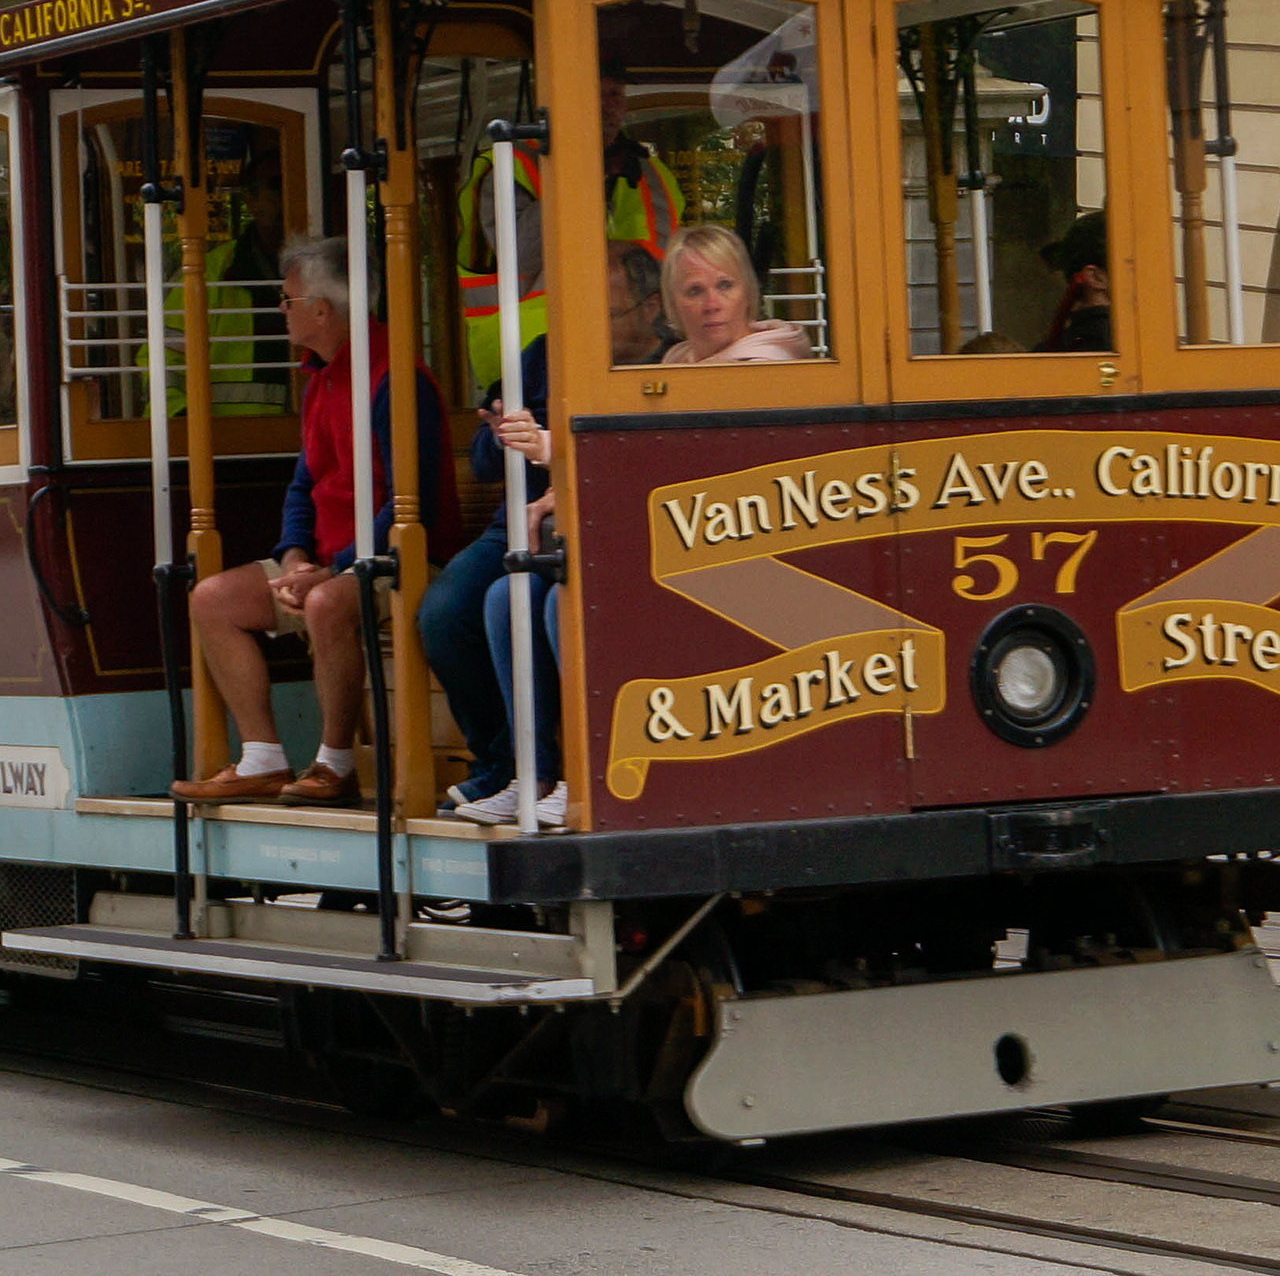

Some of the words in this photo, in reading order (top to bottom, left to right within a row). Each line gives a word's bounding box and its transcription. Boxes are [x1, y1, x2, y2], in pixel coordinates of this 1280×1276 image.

[663, 492, 773, 551] Van
[773, 468, 920, 530] Ness
[951, 529, 1098, 601] 57
[645, 686, 694, 743] &
[702, 638, 920, 741] Market
